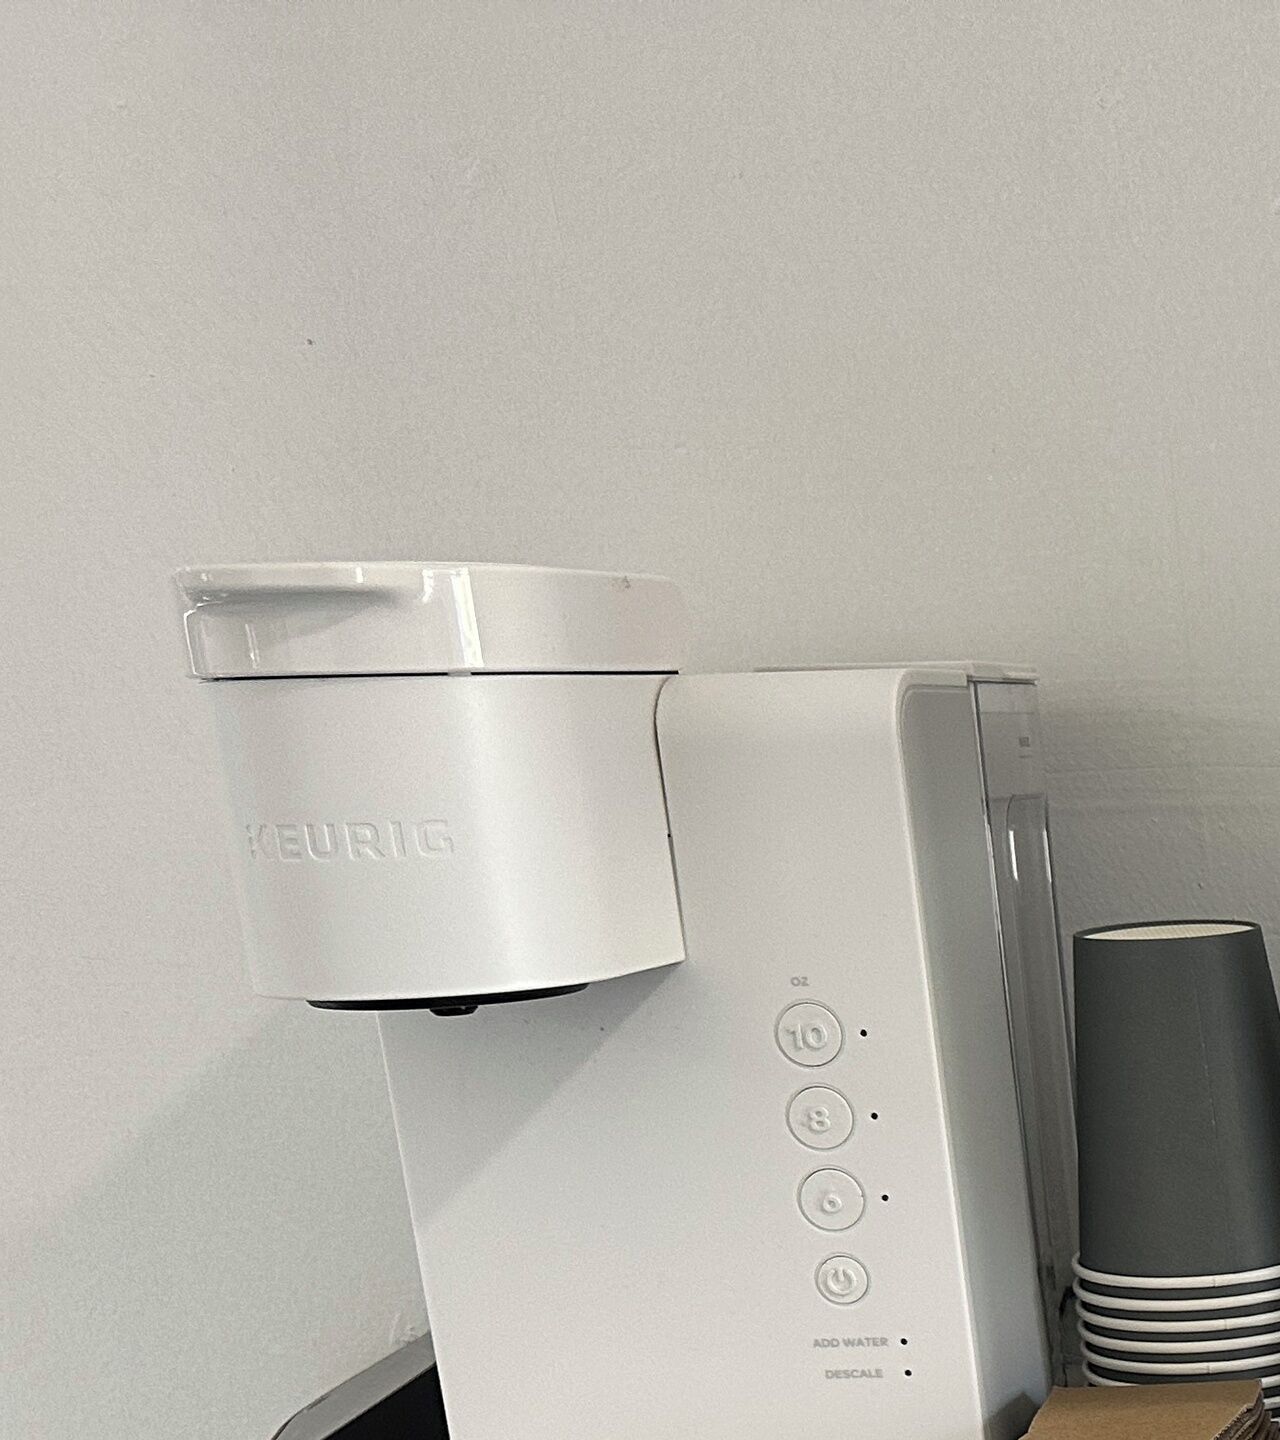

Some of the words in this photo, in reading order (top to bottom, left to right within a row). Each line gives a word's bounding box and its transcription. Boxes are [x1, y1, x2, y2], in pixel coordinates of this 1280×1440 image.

[245, 819, 454, 862] KEURIG
[789, 975, 809, 987] OZ
[785, 1022, 828, 1051] 10
[805, 1105, 831, 1134] 8
[812, 1336, 841, 1349] ADD
[842, 1336, 889, 1349] WATER
[824, 1367, 884, 1380] DESCALE
